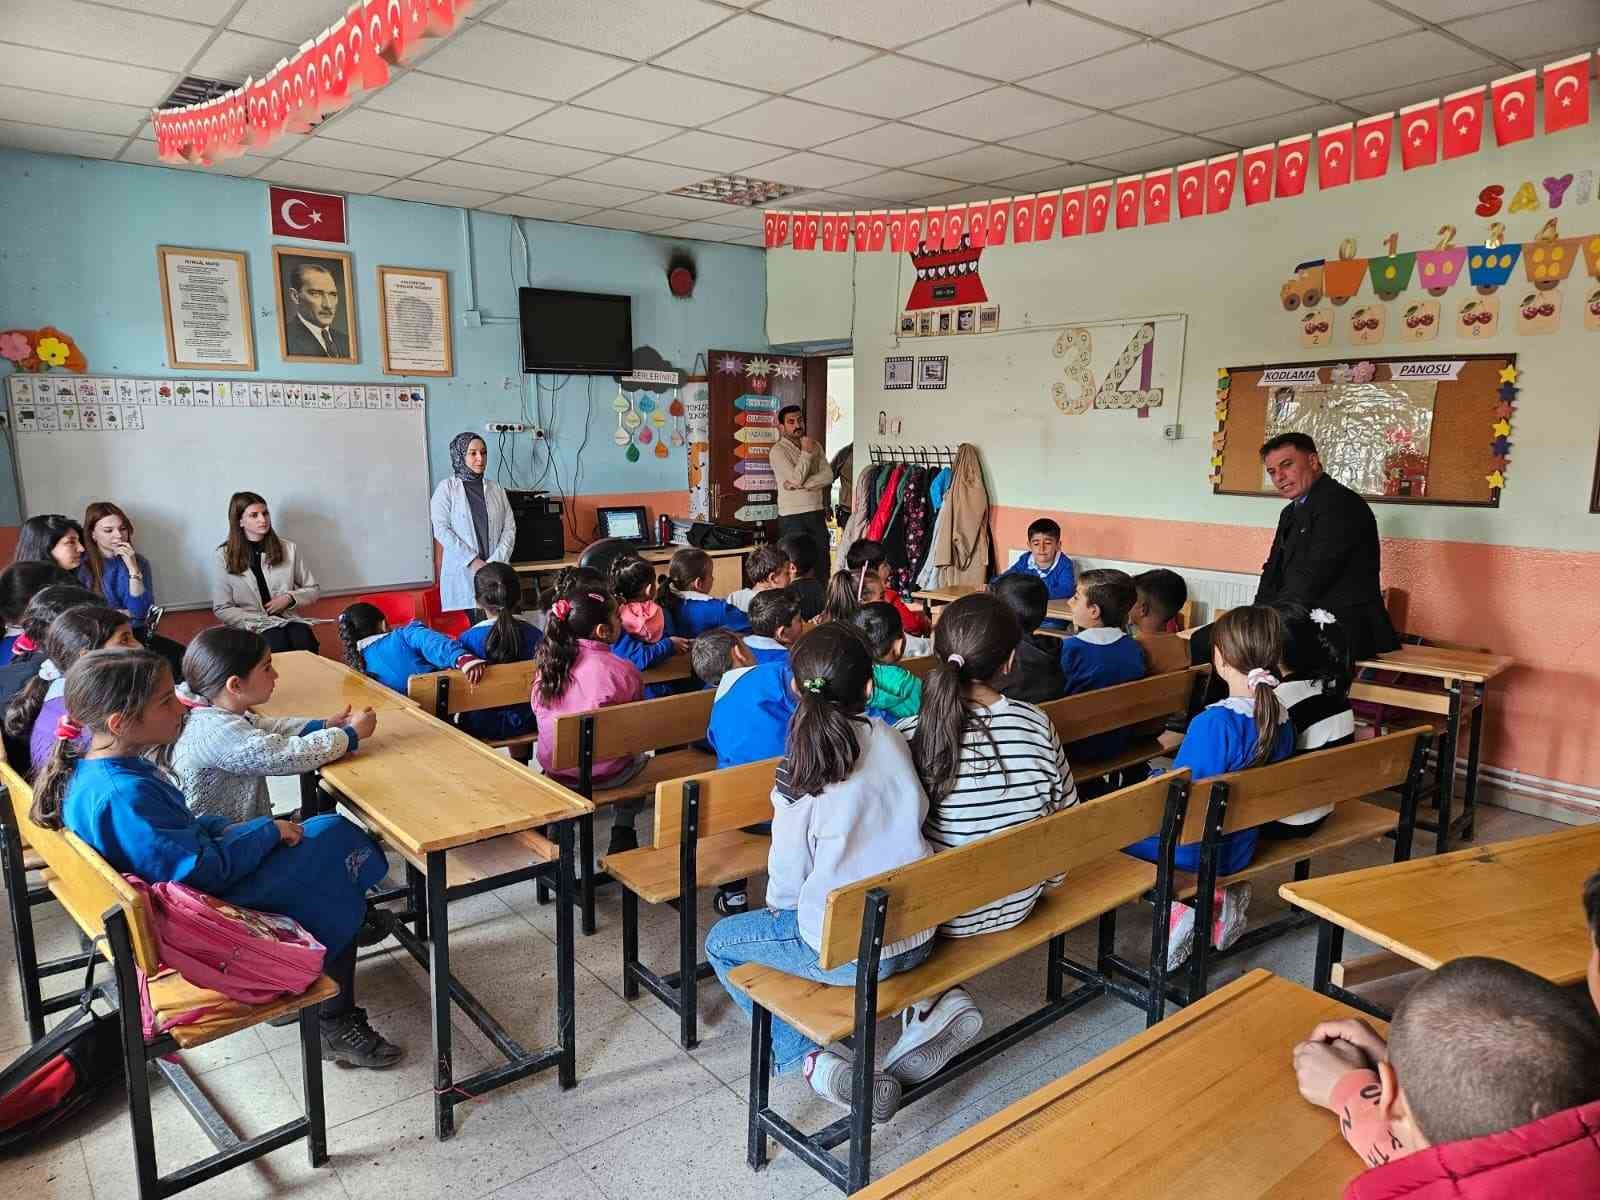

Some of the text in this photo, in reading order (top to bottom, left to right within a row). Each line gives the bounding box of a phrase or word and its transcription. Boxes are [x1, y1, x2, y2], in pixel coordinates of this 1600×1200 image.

[1474, 169, 1600, 218] SAYI
[1339, 238, 1357, 260] 0
[1383, 232, 1400, 258] 1
[1434, 224, 1456, 251] 2
[1535, 216, 1560, 242] 4
[1263, 363, 1454, 382] KODLAMA PANOSU
